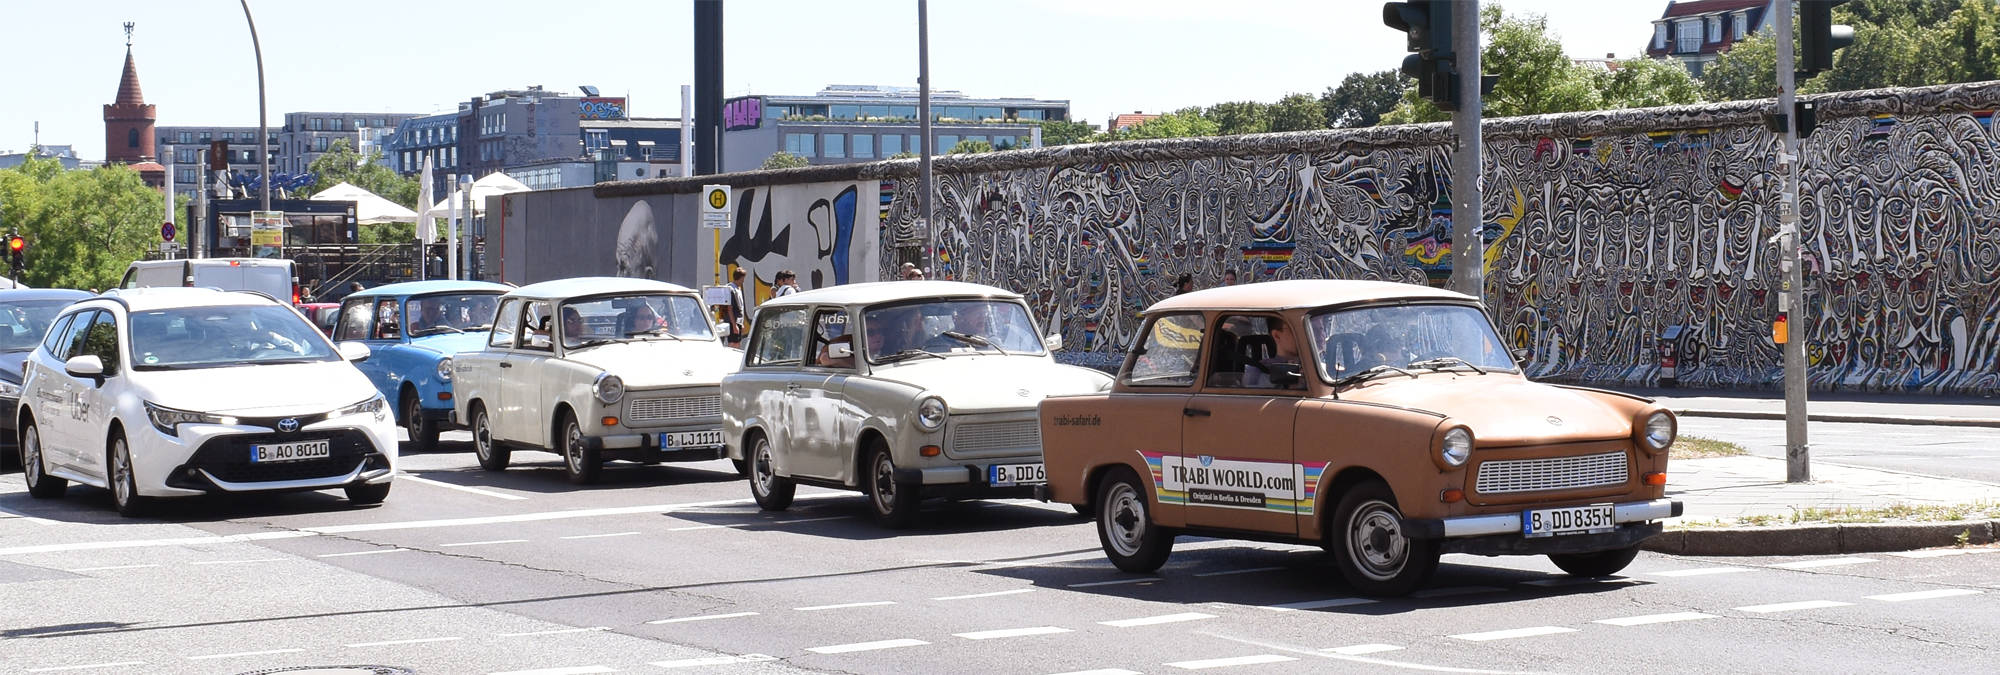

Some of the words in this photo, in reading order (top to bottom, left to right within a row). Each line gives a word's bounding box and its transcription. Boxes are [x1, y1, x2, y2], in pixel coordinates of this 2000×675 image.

[713, 193, 722, 205] H
[1053, 414, 1101, 426] trabi-safari.de
[667, 434, 674, 447] B
[681, 433, 695, 446] LJ
[696, 431, 721, 444] 1111
[258, 446, 267, 459] B
[276, 446, 293, 458] AO
[297, 443, 328, 457] 8010
[998, 467, 1007, 481] B
[1016, 466, 1034, 480] DD
[1036, 465, 1047, 480] 6
[1171, 465, 1209, 485] TRABI
[1212, 468, 1294, 491] WORLD.com
[1192, 492, 1213, 502] Original
[1212, 493, 1219, 501] in
[1219, 494, 1235, 502] Berlin
[1240, 495, 1262, 504] Dresden
[1532, 512, 1542, 531] B
[1551, 511, 1572, 529] DD
[1574, 507, 1613, 528] 835H
